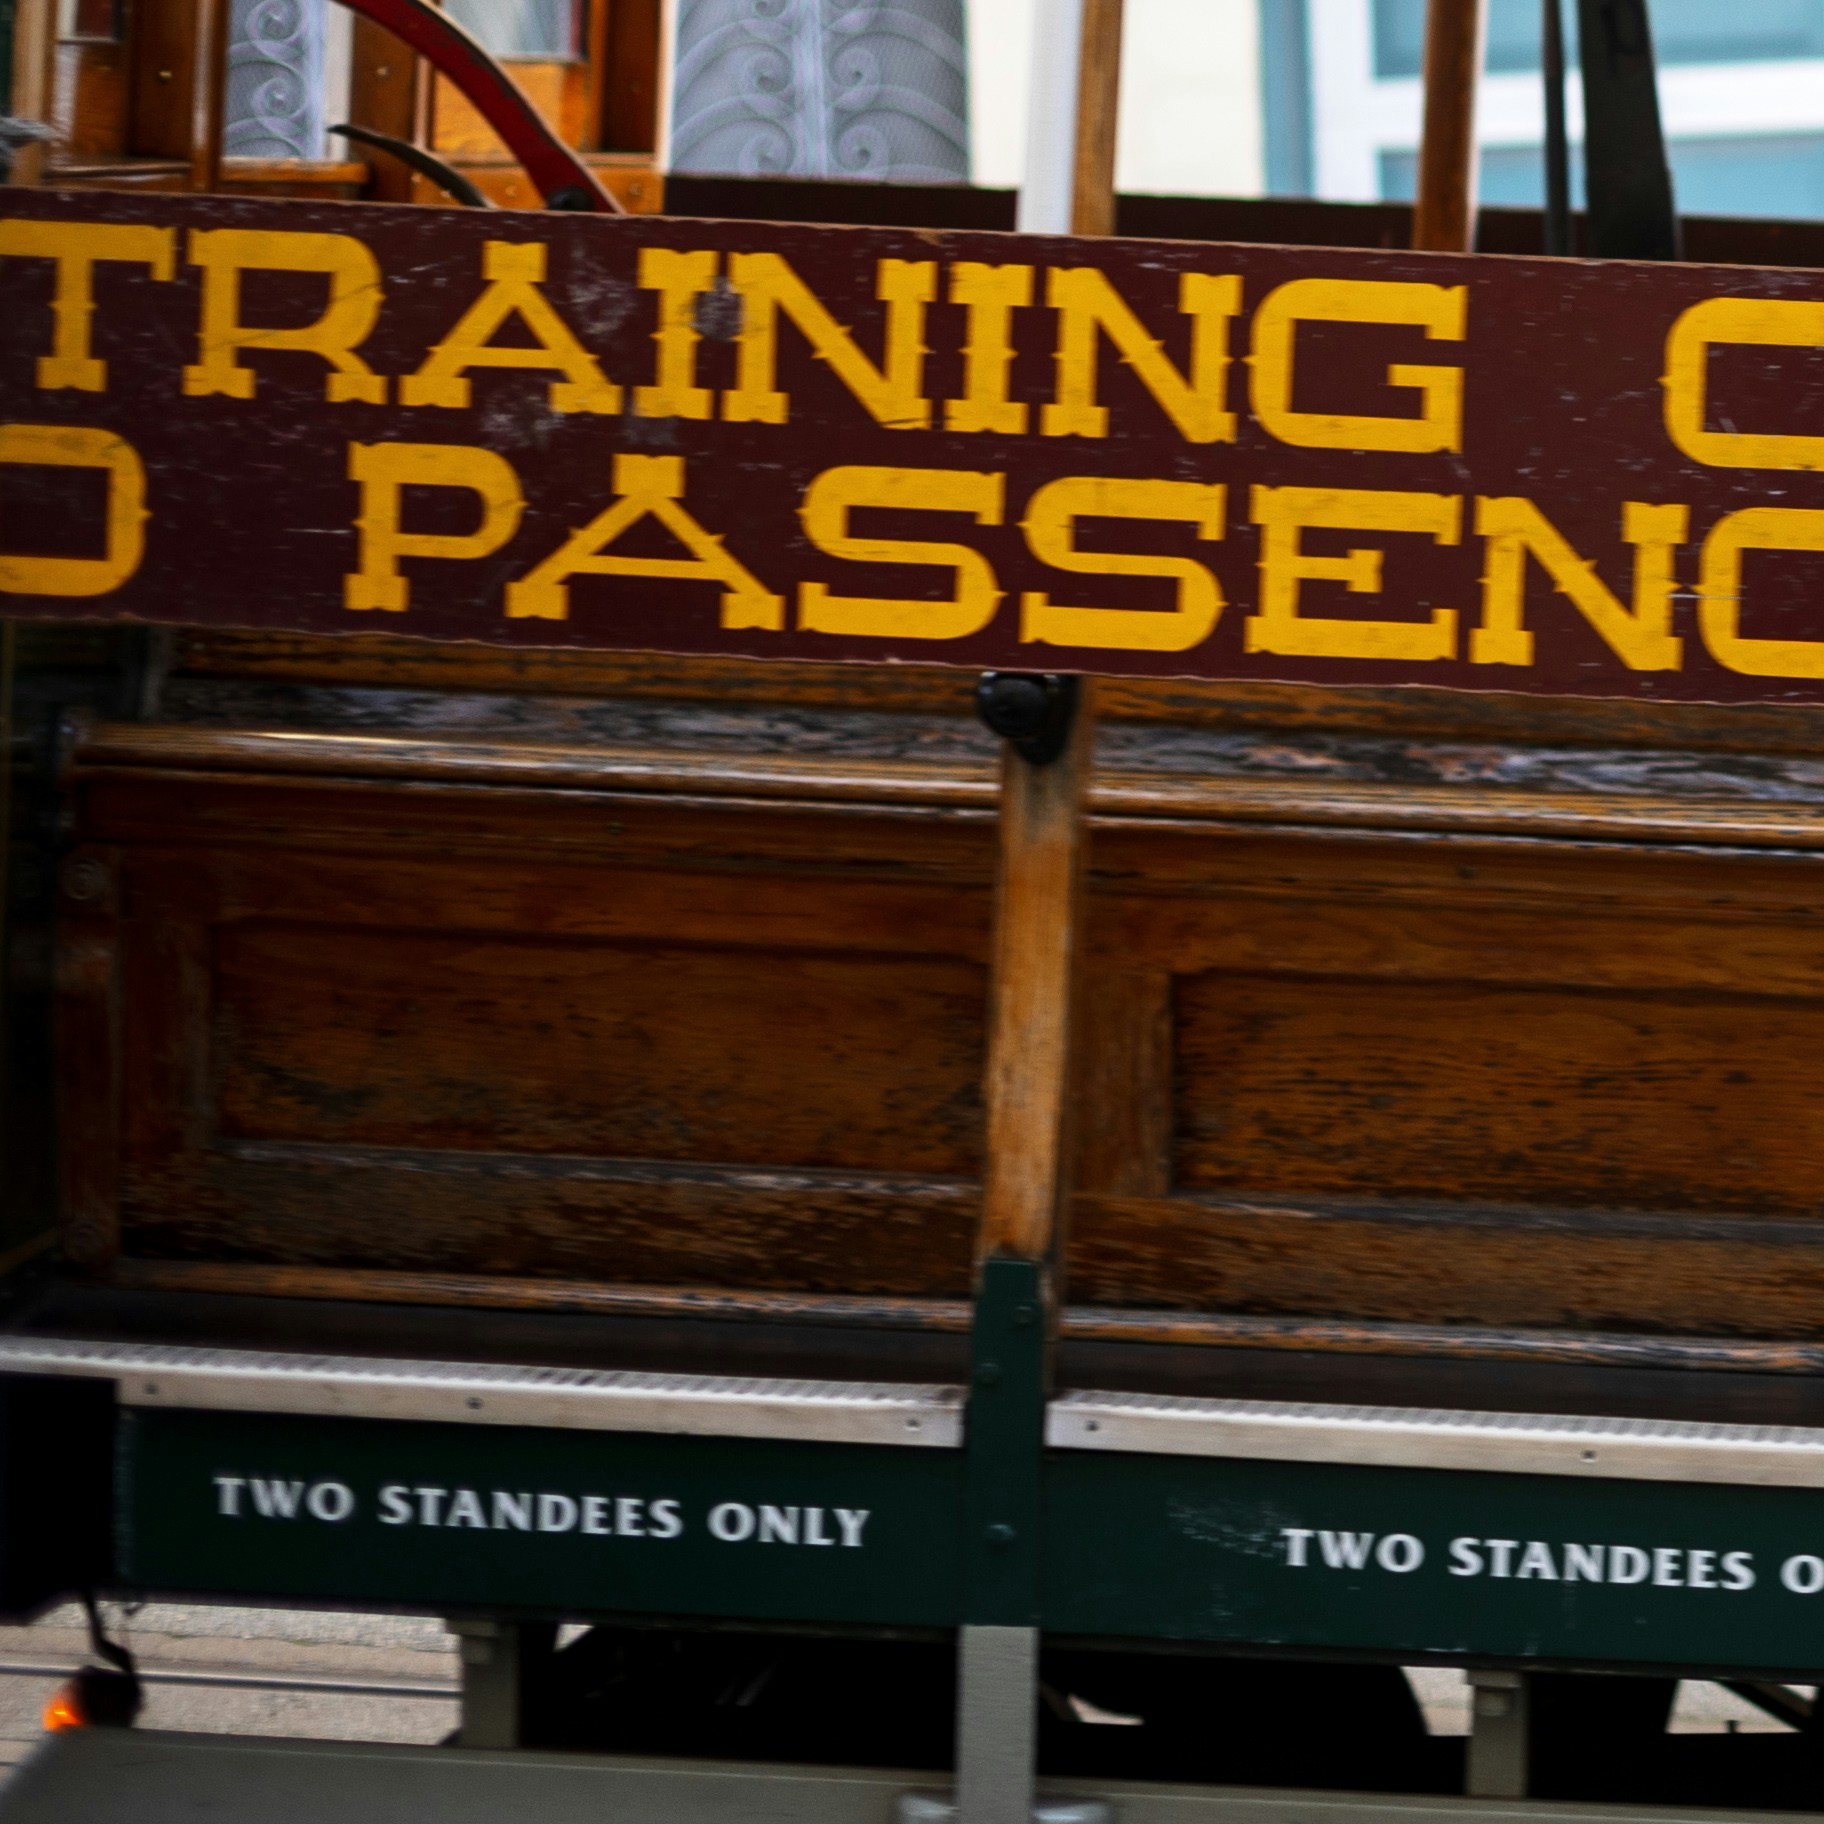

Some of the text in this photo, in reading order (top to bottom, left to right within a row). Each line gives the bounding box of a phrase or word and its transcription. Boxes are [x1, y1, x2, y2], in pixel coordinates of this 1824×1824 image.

[0, 217, 1468, 453] TRAINING
[0, 423, 153, 597] O
[215, 1476, 871, 1548] TWO STANDEES ONLY
[1280, 1526, 1425, 1574] TWO
[1448, 1535, 1756, 1592] STANDEES
